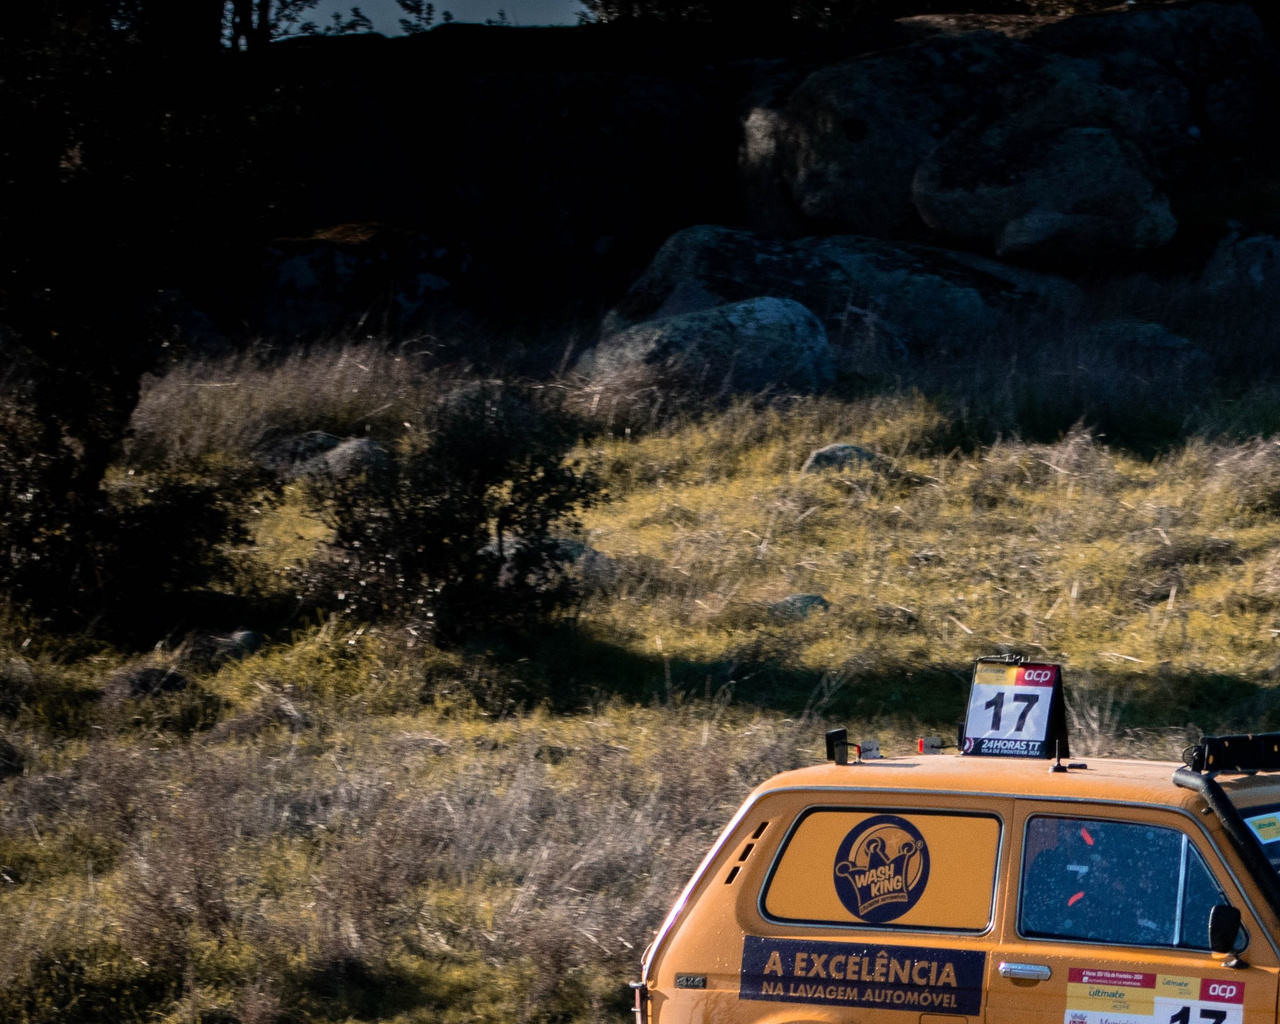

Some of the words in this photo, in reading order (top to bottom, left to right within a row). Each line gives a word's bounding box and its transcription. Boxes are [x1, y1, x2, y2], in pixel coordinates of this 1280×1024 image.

[1024, 670, 1051, 683] acp
[985, 692, 1040, 732] 17
[981, 739, 1027, 750] 24HORAS
[1028, 742, 1041, 751] TT
[855, 863, 895, 889] WASH
[870, 875, 902, 897] KING
[763, 951, 784, 977] A
[793, 950, 958, 988] EXCELÊNCIA
[762, 981, 785, 996] NA
[789, 983, 859, 1001] LAVAGEM
[861, 988, 958, 1008] AUTOMÓVEL
[1089, 989, 1125, 998] ultimate
[1209, 984, 1236, 998] acp
